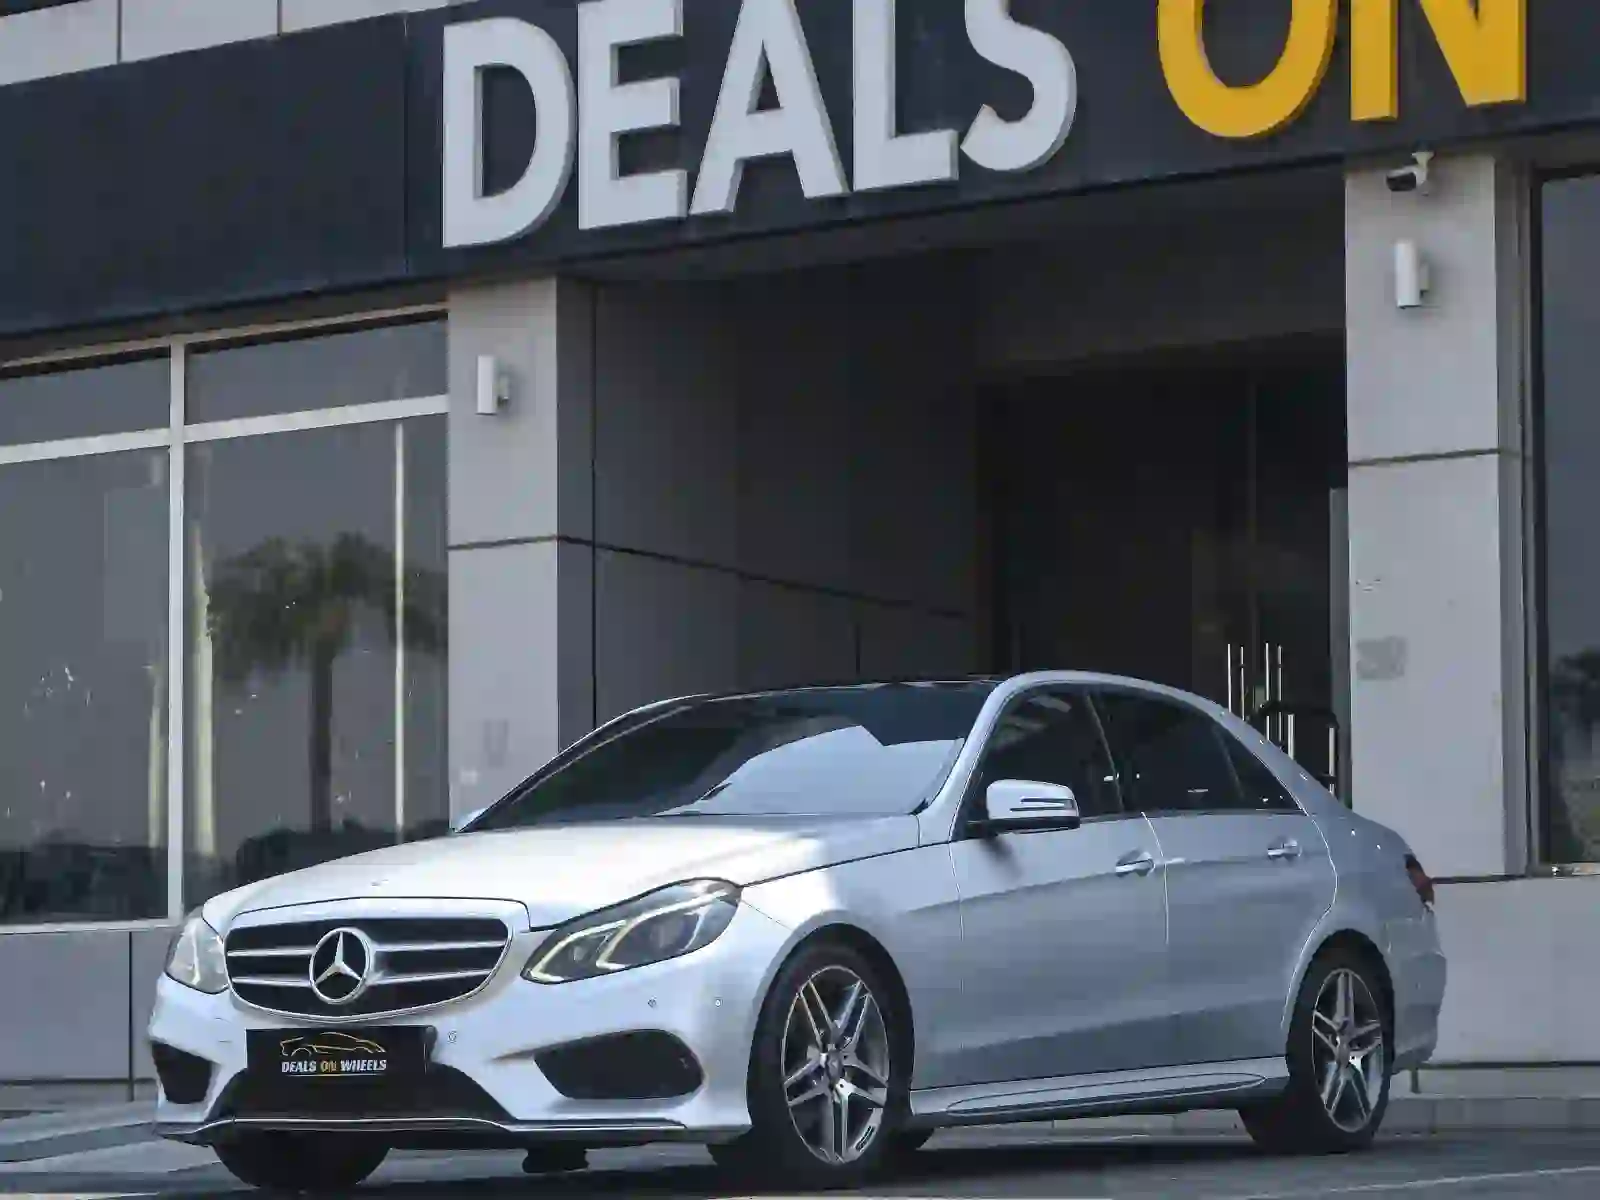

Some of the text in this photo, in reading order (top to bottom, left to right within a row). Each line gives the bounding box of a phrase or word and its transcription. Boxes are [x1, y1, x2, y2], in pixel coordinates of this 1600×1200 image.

[441, 0, 1077, 248] DEALS
[281, 1059, 387, 1073] DEALS ON WHEELS
